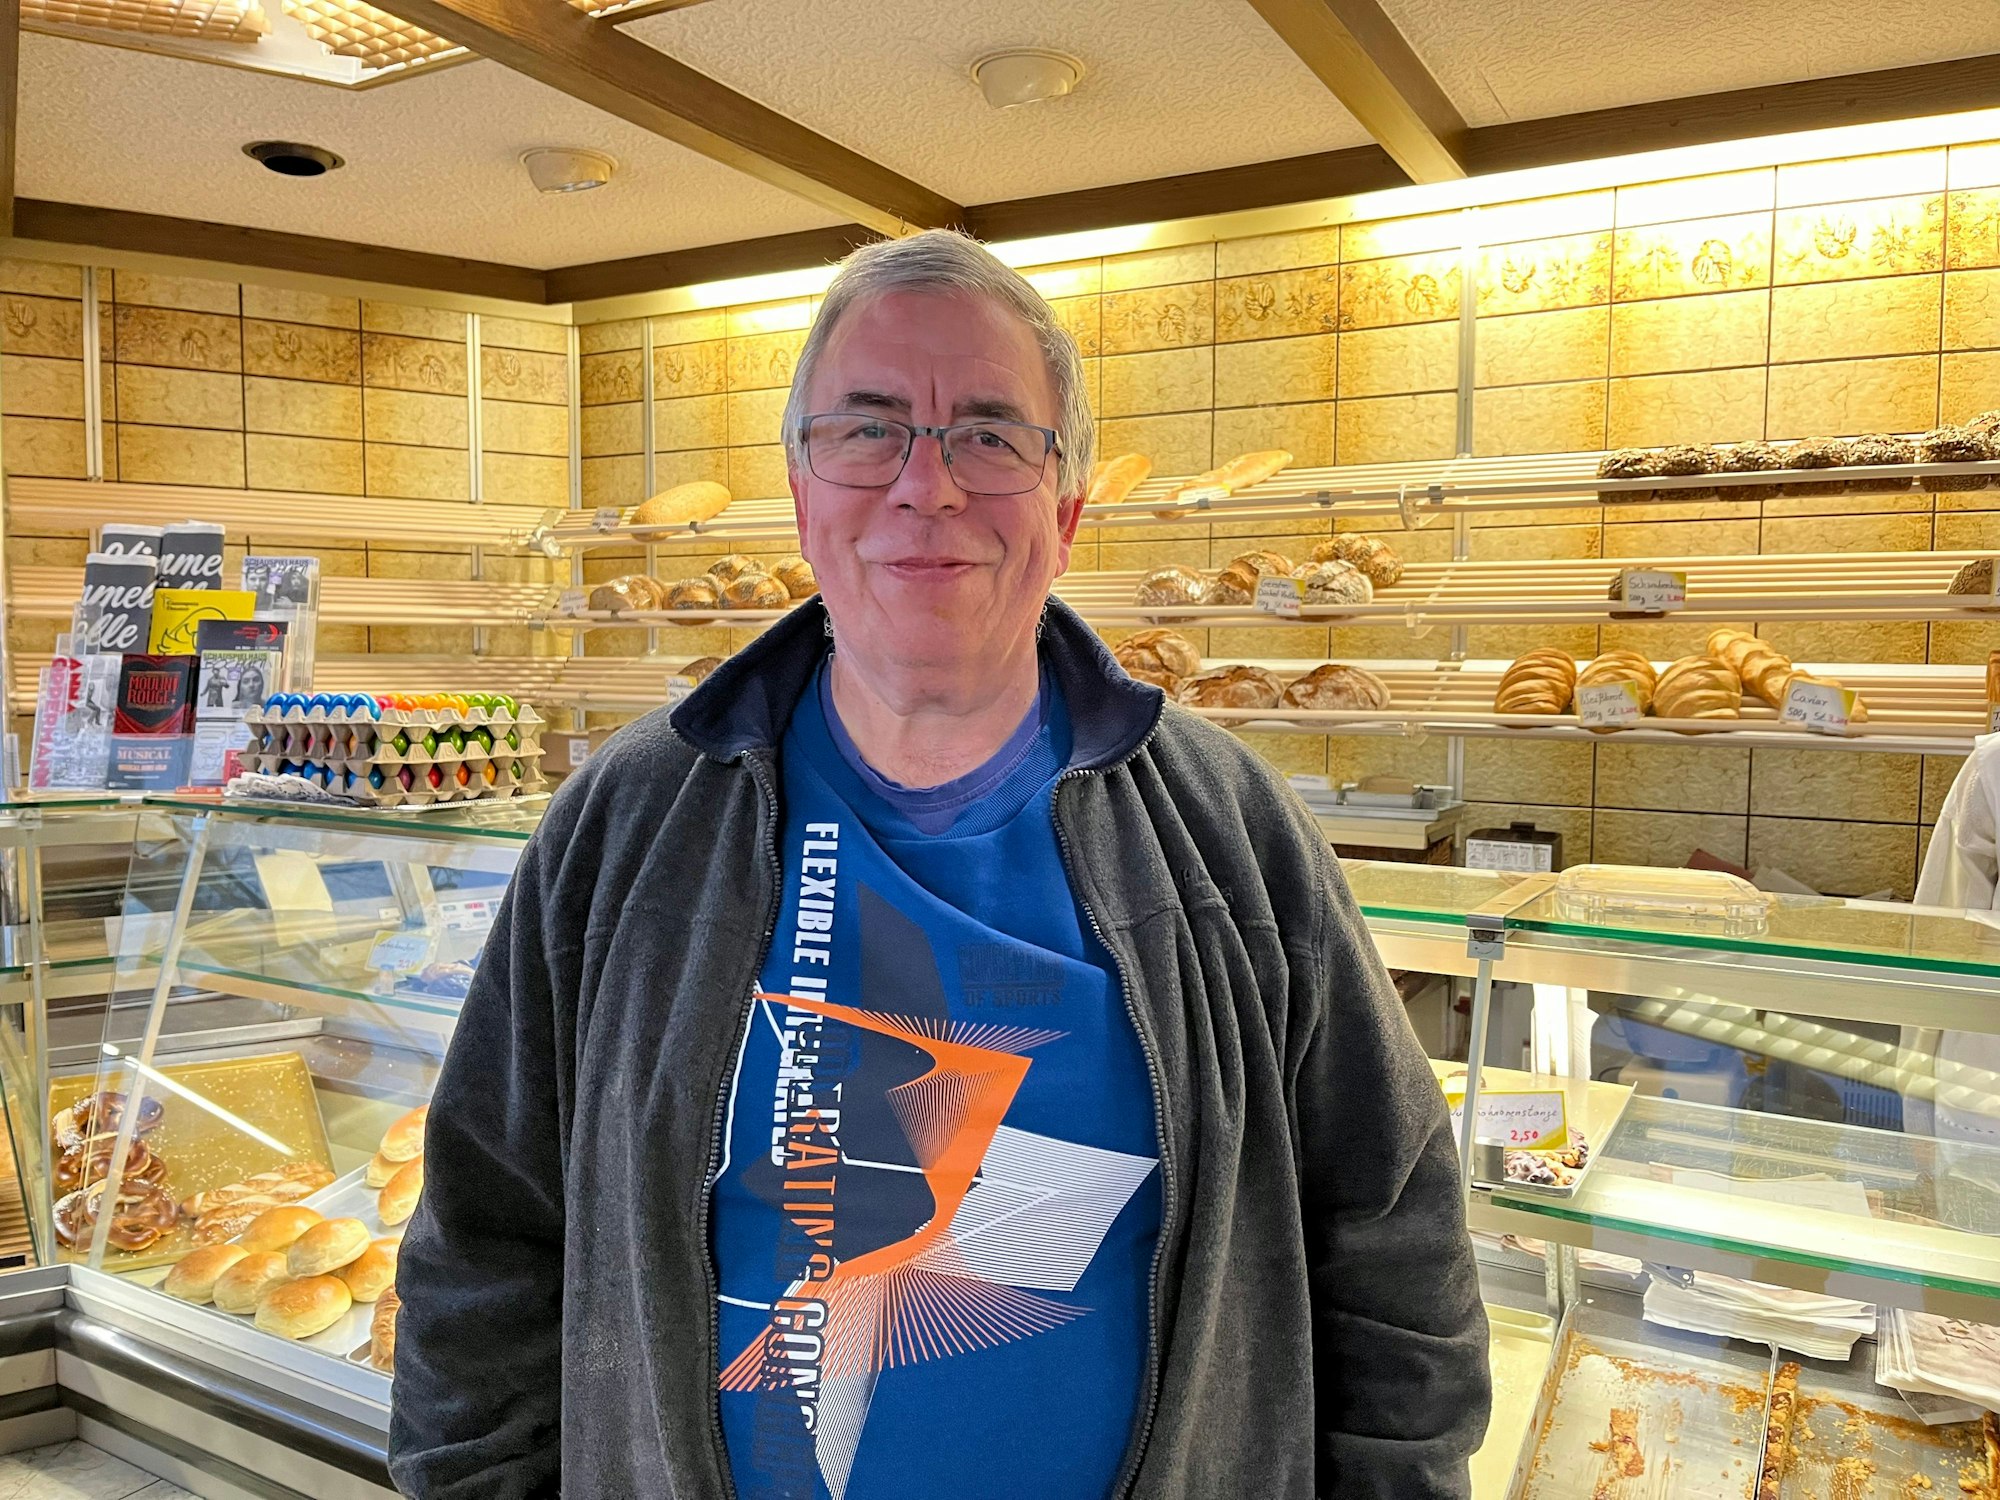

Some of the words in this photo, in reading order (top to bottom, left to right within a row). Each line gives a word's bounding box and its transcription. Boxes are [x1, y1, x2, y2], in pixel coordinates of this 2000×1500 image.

[66, 657, 83, 713] ANNA
[1791, 689, 1828, 706] Caviar
[1584, 710, 1602, 721] 500g
[1787, 707, 1807, 721] 500g
[33, 657, 68, 788] OPPERMANN
[117, 750, 171, 760] MUSICAL
[793, 822, 839, 966] FLEXIBLE
[1511, 1129, 1538, 1142] 2,50
